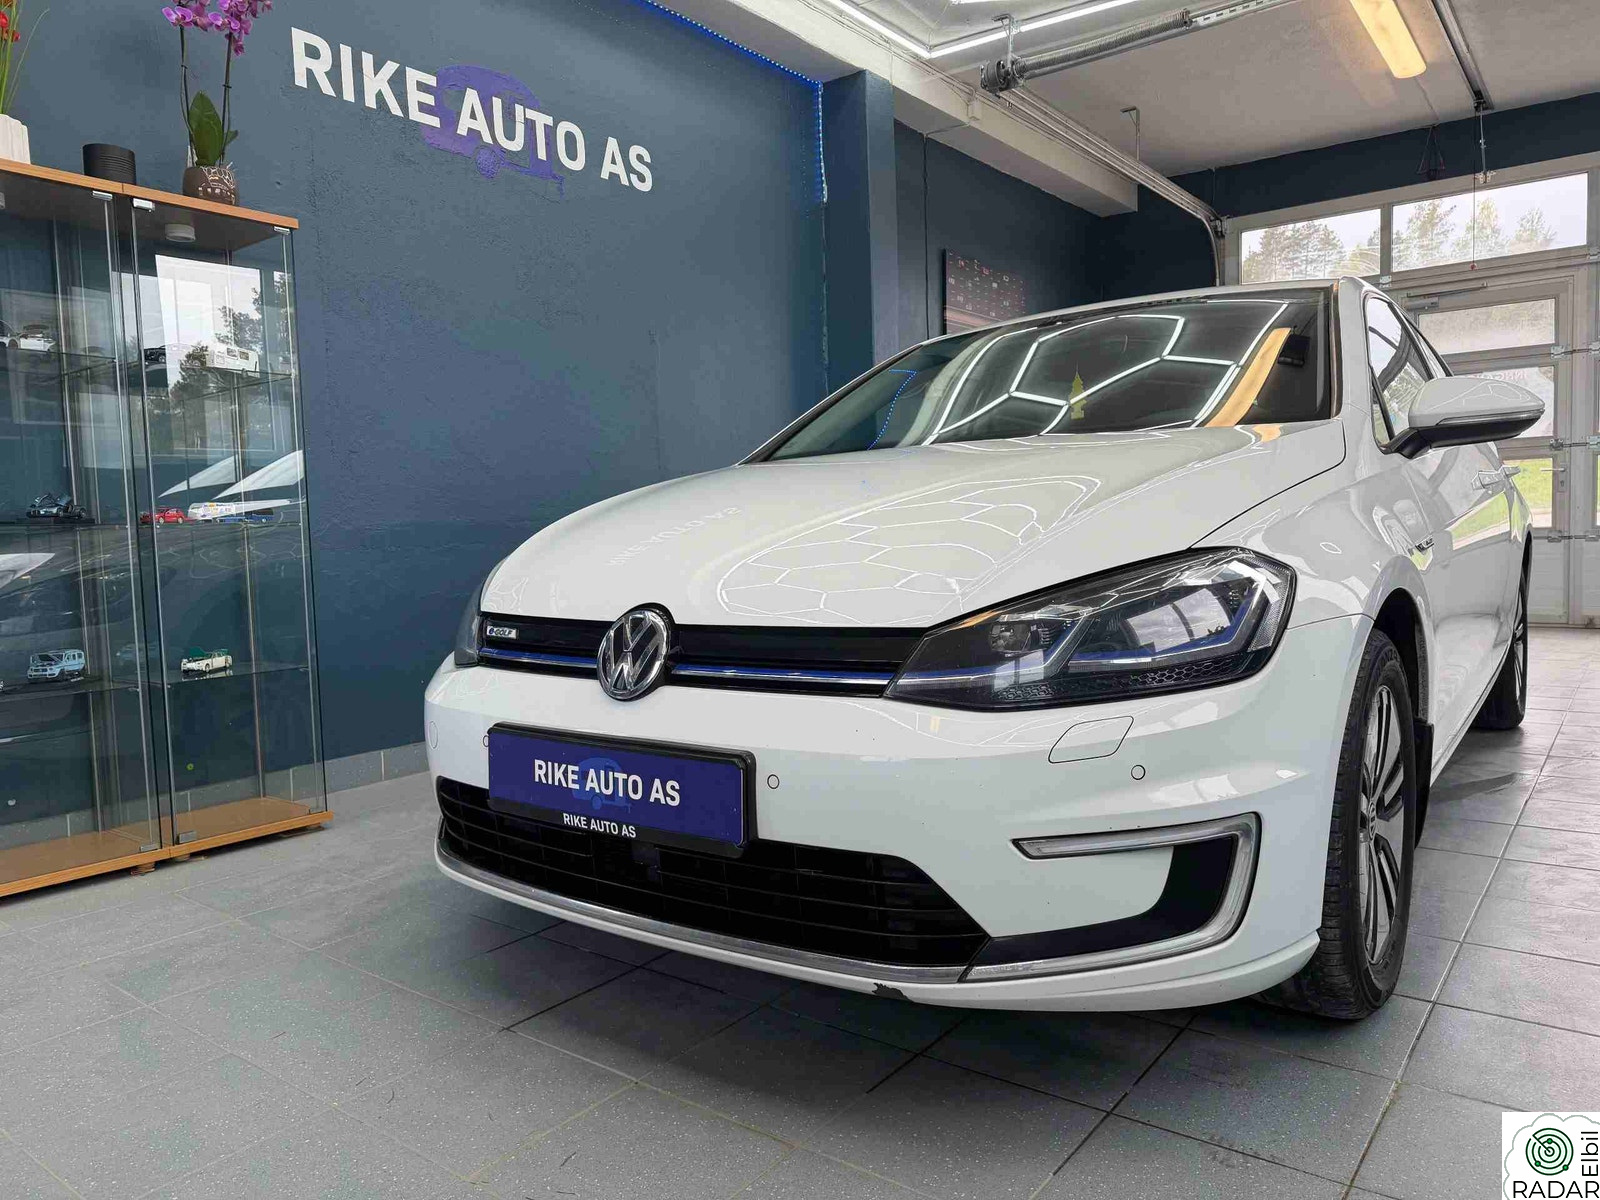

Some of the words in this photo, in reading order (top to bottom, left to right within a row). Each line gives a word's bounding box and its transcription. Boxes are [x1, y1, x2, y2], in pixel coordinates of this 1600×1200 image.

[291, 26, 441, 129] RIKE
[456, 86, 586, 171] AUTO
[600, 136, 653, 192] AS
[534, 758, 580, 790] RIKE
[585, 768, 643, 800] AUTO
[649, 778, 680, 807] AS
[562, 812, 588, 829] RIKE
[590, 818, 619, 835] AUTO
[621, 824, 637, 839] AS
